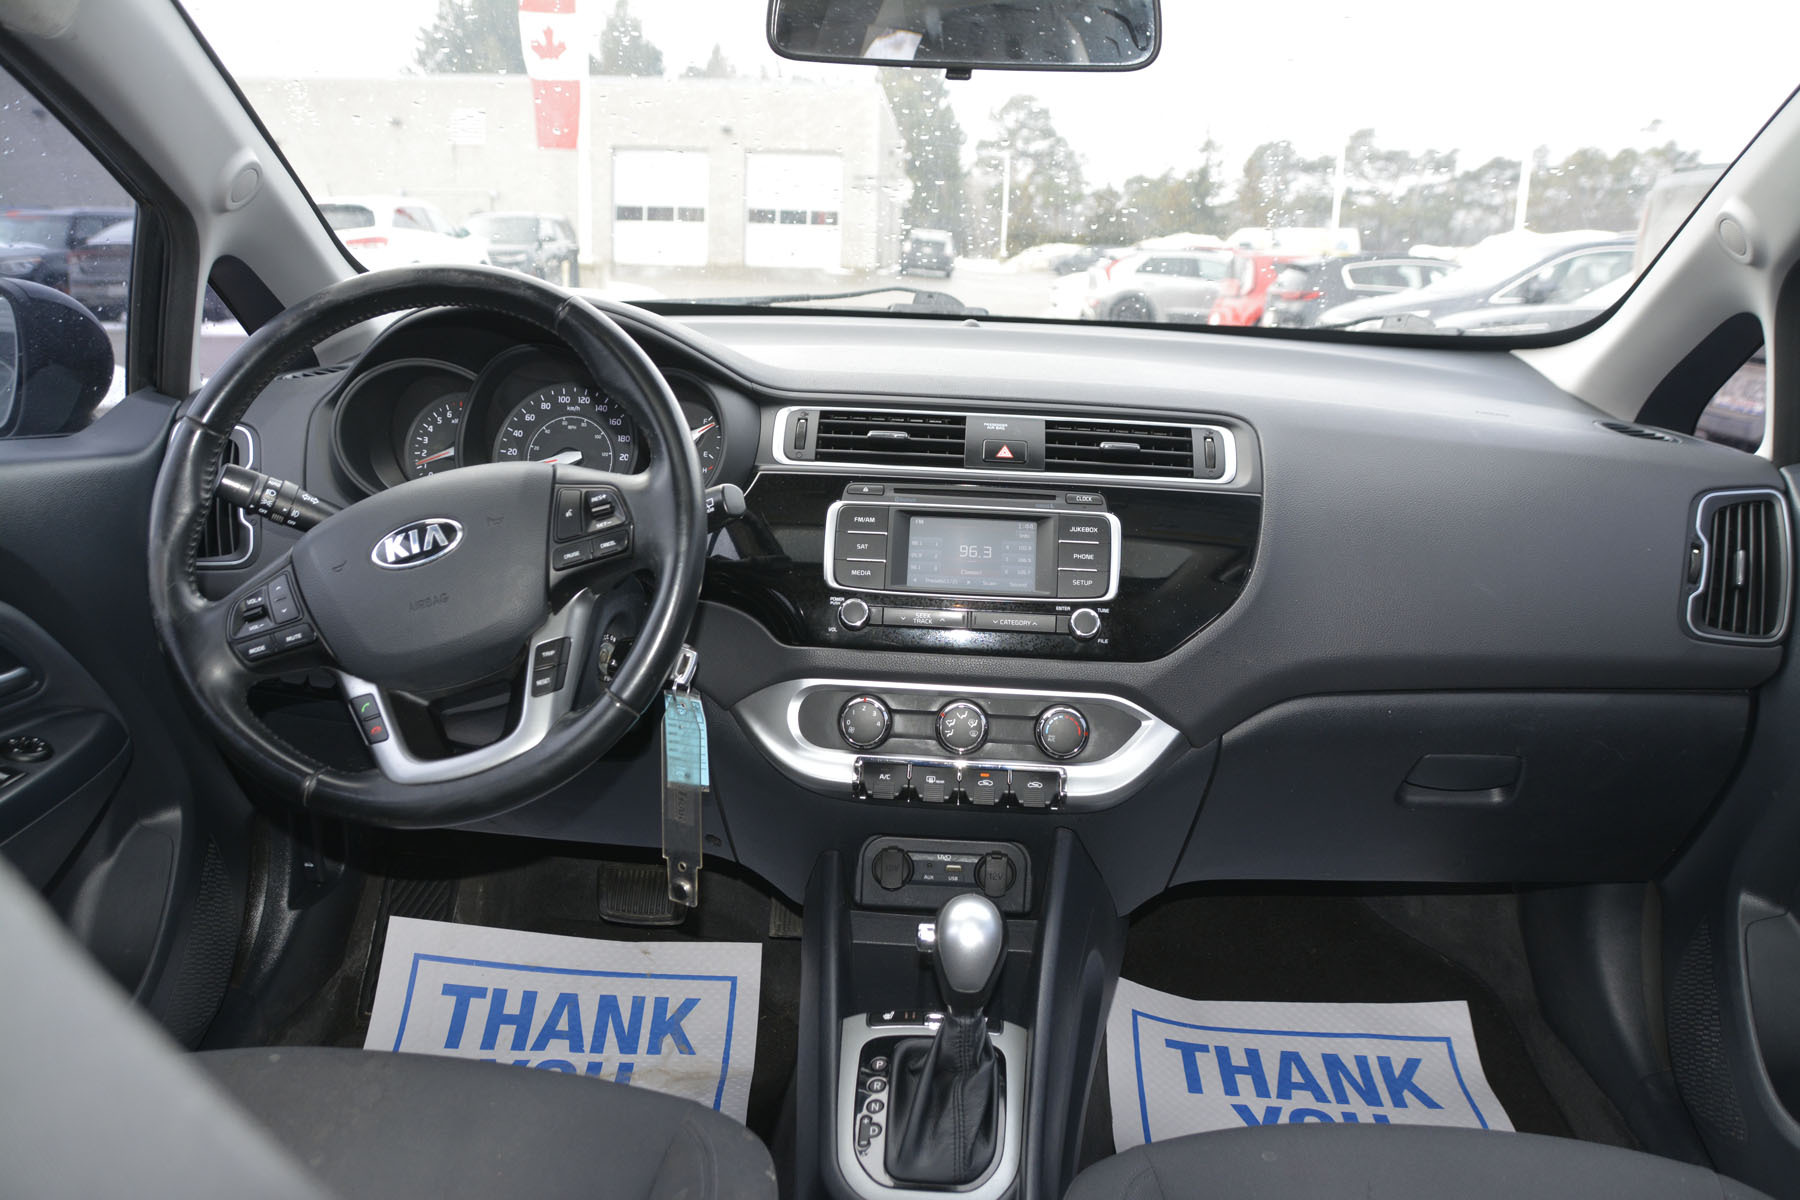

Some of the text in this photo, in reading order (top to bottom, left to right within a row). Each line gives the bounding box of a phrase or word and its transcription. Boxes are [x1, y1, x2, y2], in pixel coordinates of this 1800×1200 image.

[558, 396, 571, 404] 100
[578, 396, 590, 404] 120
[540, 402, 551, 410] 80
[595, 404, 608, 413] 140
[609, 418, 622, 426] 160
[617, 434, 630, 443] 180
[507, 448, 518, 456] 20
[384, 524, 449, 563] KIA
[959, 544, 992, 559] 96.3
[409, 592, 449, 611] AIRBAG
[248, 644, 266, 655] MODE
[440, 982, 702, 1056] THANK
[876, 1060, 884, 1068] P
[1164, 1037, 1445, 1110] THANK
[873, 1082, 882, 1090] R
[871, 1102, 879, 1111] N
[870, 1127, 879, 1135] D
